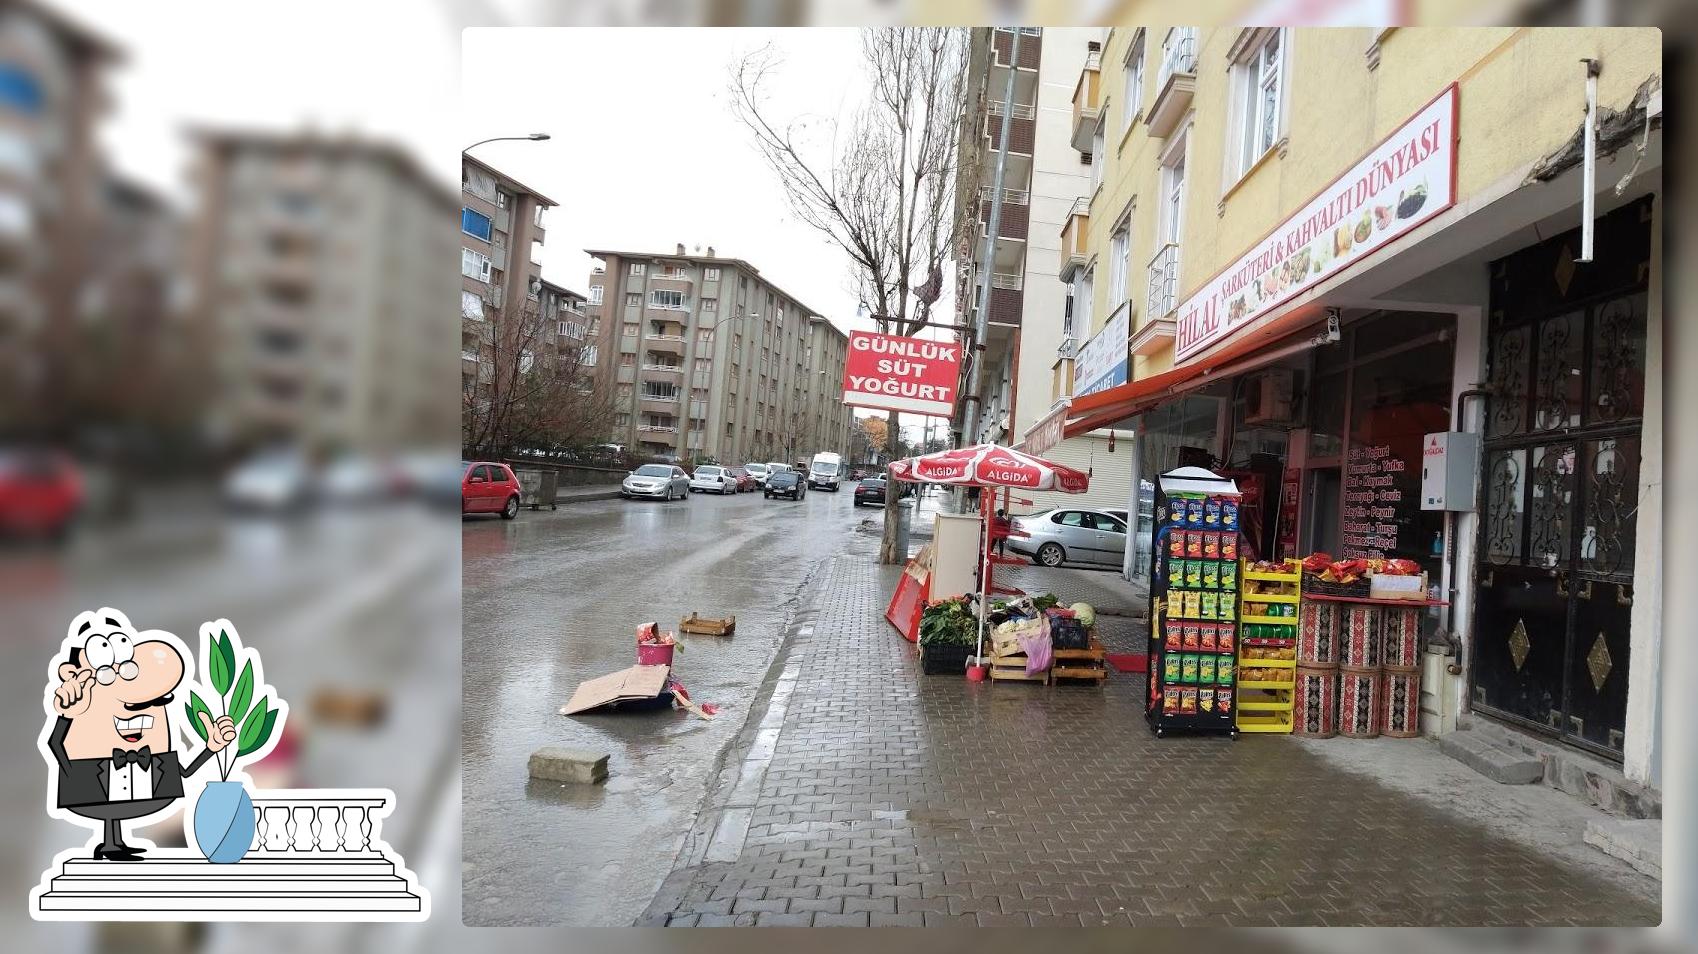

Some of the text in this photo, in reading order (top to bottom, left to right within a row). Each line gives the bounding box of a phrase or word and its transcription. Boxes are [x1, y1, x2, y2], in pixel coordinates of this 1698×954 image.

[1177, 293, 1220, 352] HİLAL
[1221, 241, 1275, 304] ŞARKÜTERİ
[1275, 241, 1284, 264] &
[1286, 186, 1352, 257] KAHVALTI
[1355, 118, 1441, 209] DÜNYASI
[853, 336, 957, 362] GÜNLÜK
[877, 359, 927, 377] SÜT
[849, 375, 951, 400] YOĞURT
[1381, 459, 1404, 472] Yufka
[1380, 489, 1401, 501] Ceviz
[1370, 505, 1395, 520] Peynir
[1375, 522, 1398, 537] Turşu
[1374, 536, 1397, 550] Reçel
